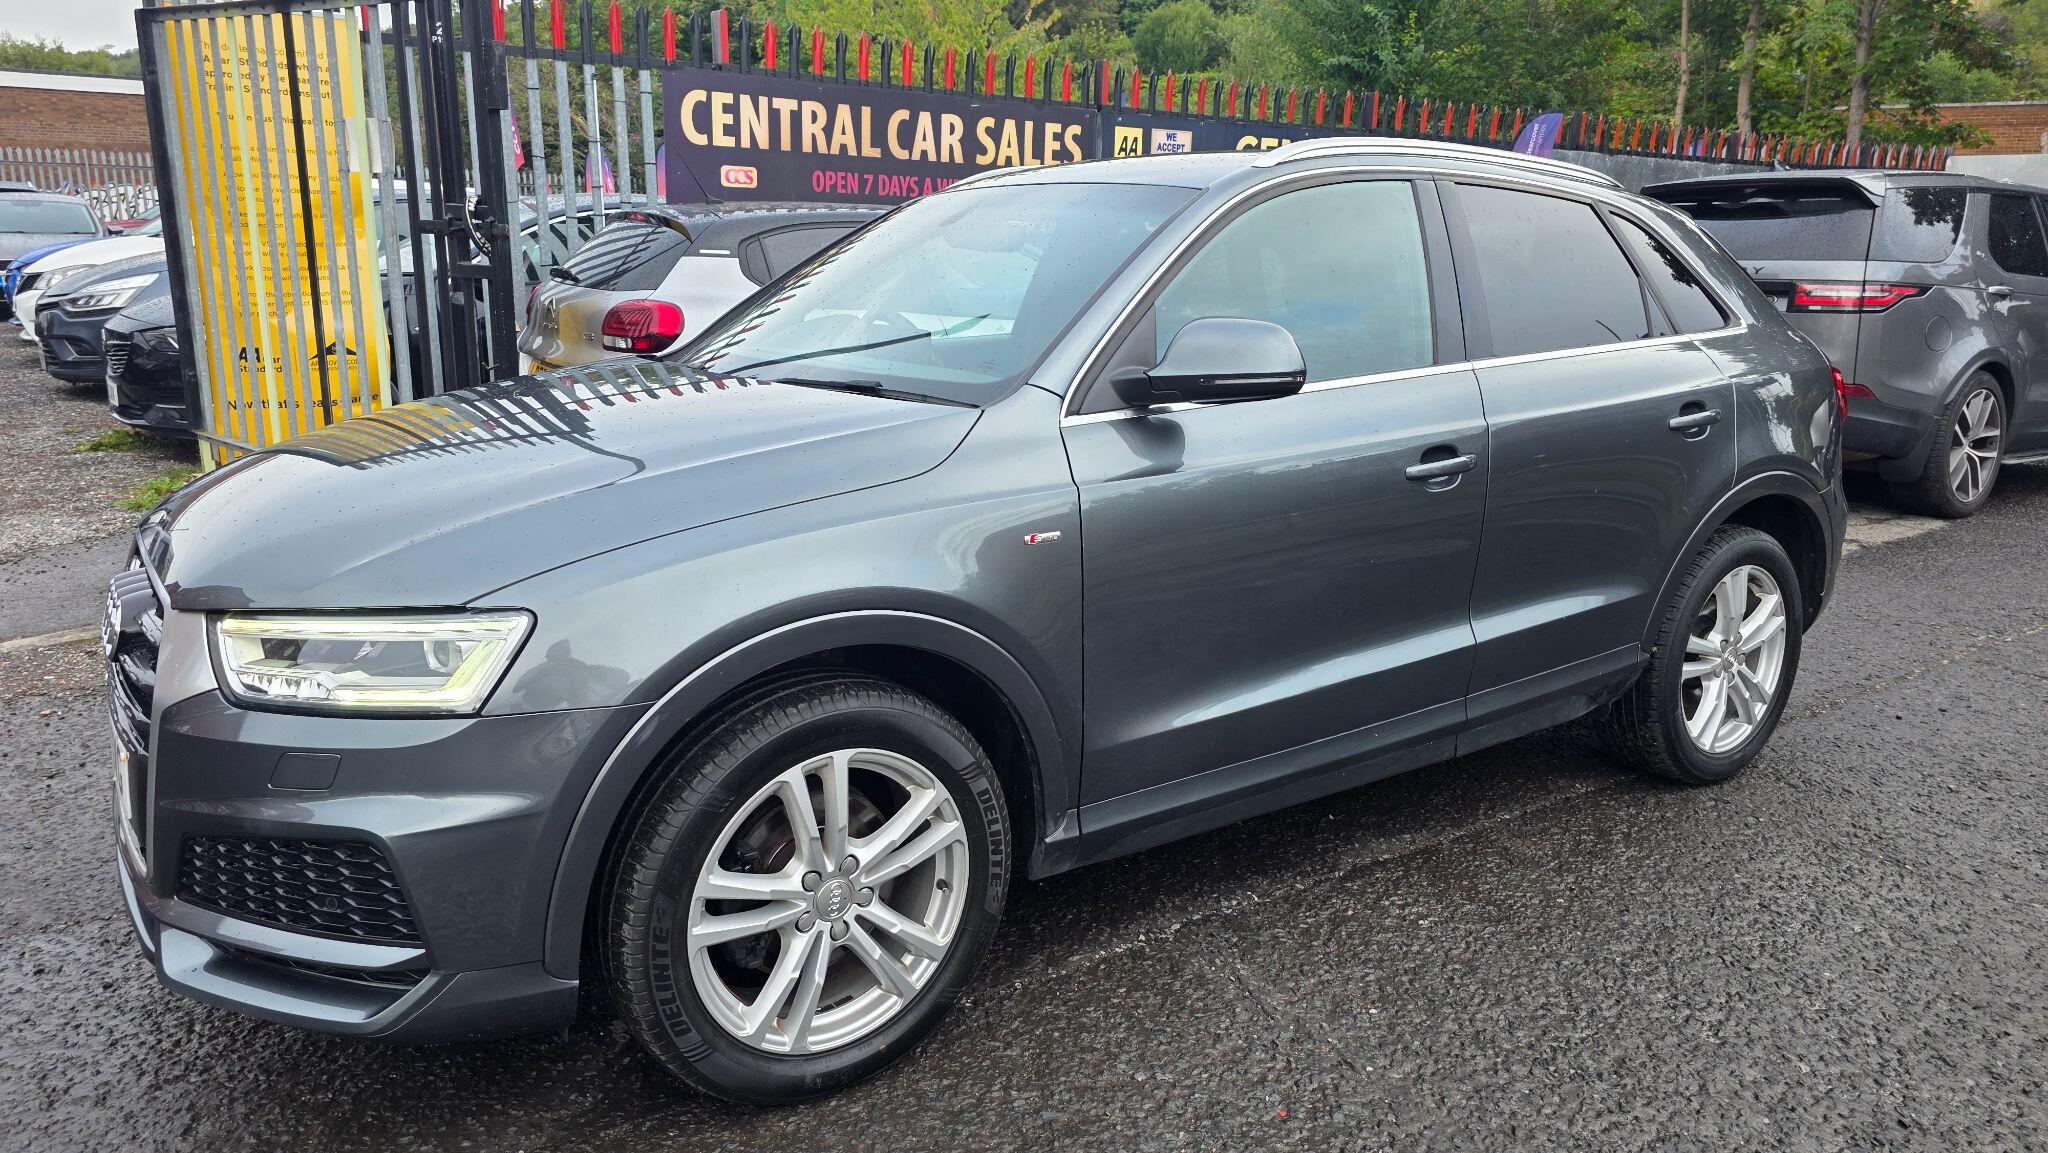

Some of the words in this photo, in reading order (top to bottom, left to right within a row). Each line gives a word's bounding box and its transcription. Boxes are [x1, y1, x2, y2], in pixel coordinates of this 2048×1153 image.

[681, 89, 882, 158] CENTRAL
[888, 109, 964, 164] CAR
[976, 117, 1083, 167] SALES
[1166, 132, 1178, 142] WE
[1117, 136, 1138, 156] AA
[1156, 142, 1186, 153] ACCEPT
[812, 170, 859, 194] OPEN
[863, 174, 874, 195] 7
[878, 174, 919, 198] DAYS
[922, 177, 934, 196] A
[974, 786, 1004, 893] DELINTE
[651, 926, 694, 1039] DELINTE
